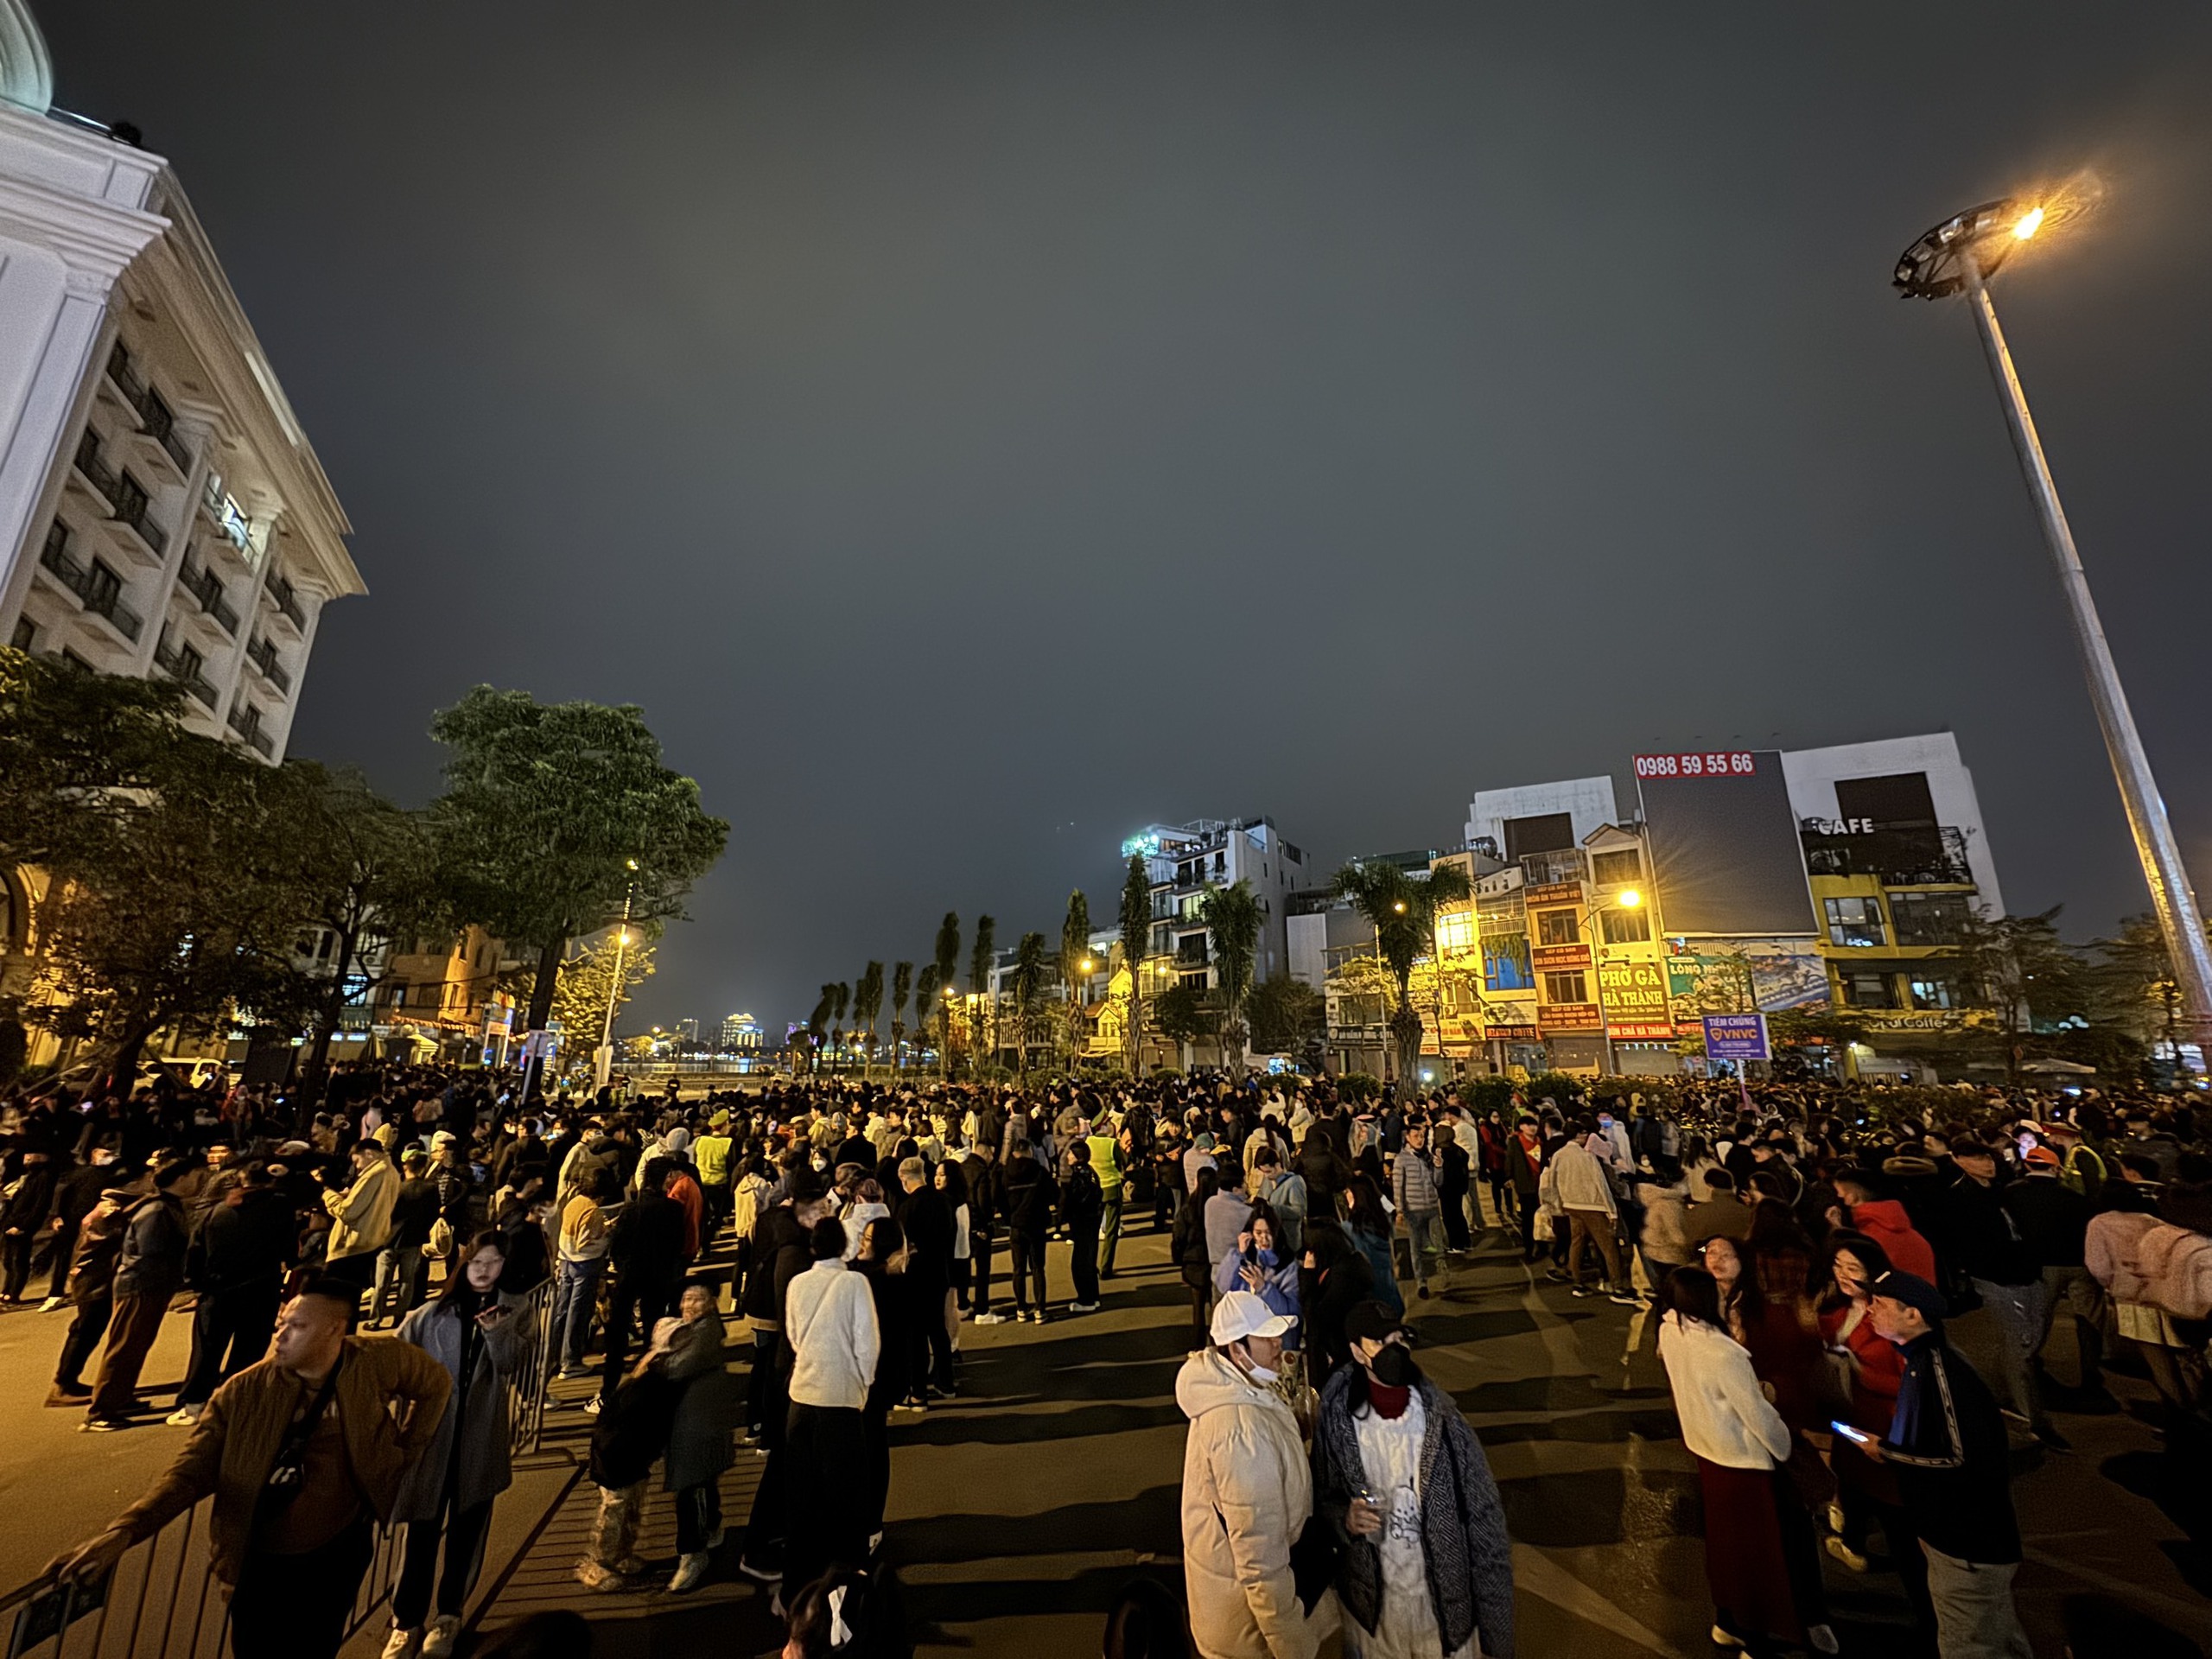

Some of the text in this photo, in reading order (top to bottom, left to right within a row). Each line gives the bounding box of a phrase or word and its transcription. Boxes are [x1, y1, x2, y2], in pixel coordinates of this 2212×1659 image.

[1637, 753, 1752, 776] 0988 59 55 66
[1599, 964, 1662, 987] PHỞ GÀ
[1602, 988, 1664, 1007] HÀ THÀNH
[1723, 1028, 1758, 1039] VNVC
